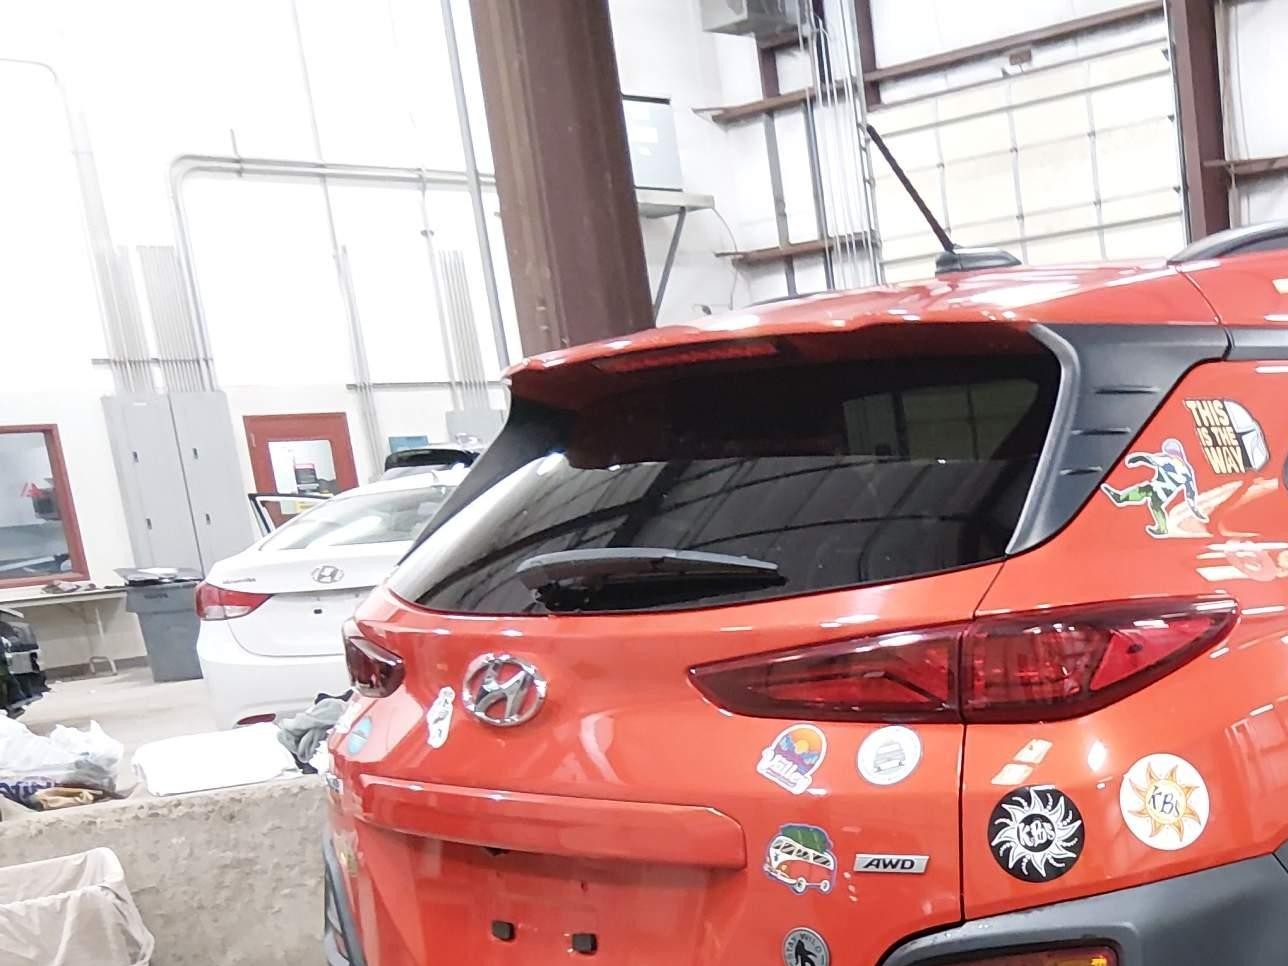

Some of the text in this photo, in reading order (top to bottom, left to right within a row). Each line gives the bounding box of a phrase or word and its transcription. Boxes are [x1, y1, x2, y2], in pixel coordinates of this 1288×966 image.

[1185, 400, 1230, 427] THIS
[1197, 427, 1239, 447] IS THE
[1205, 447, 1246, 475] WAY
[863, 858, 915, 870] AWD
